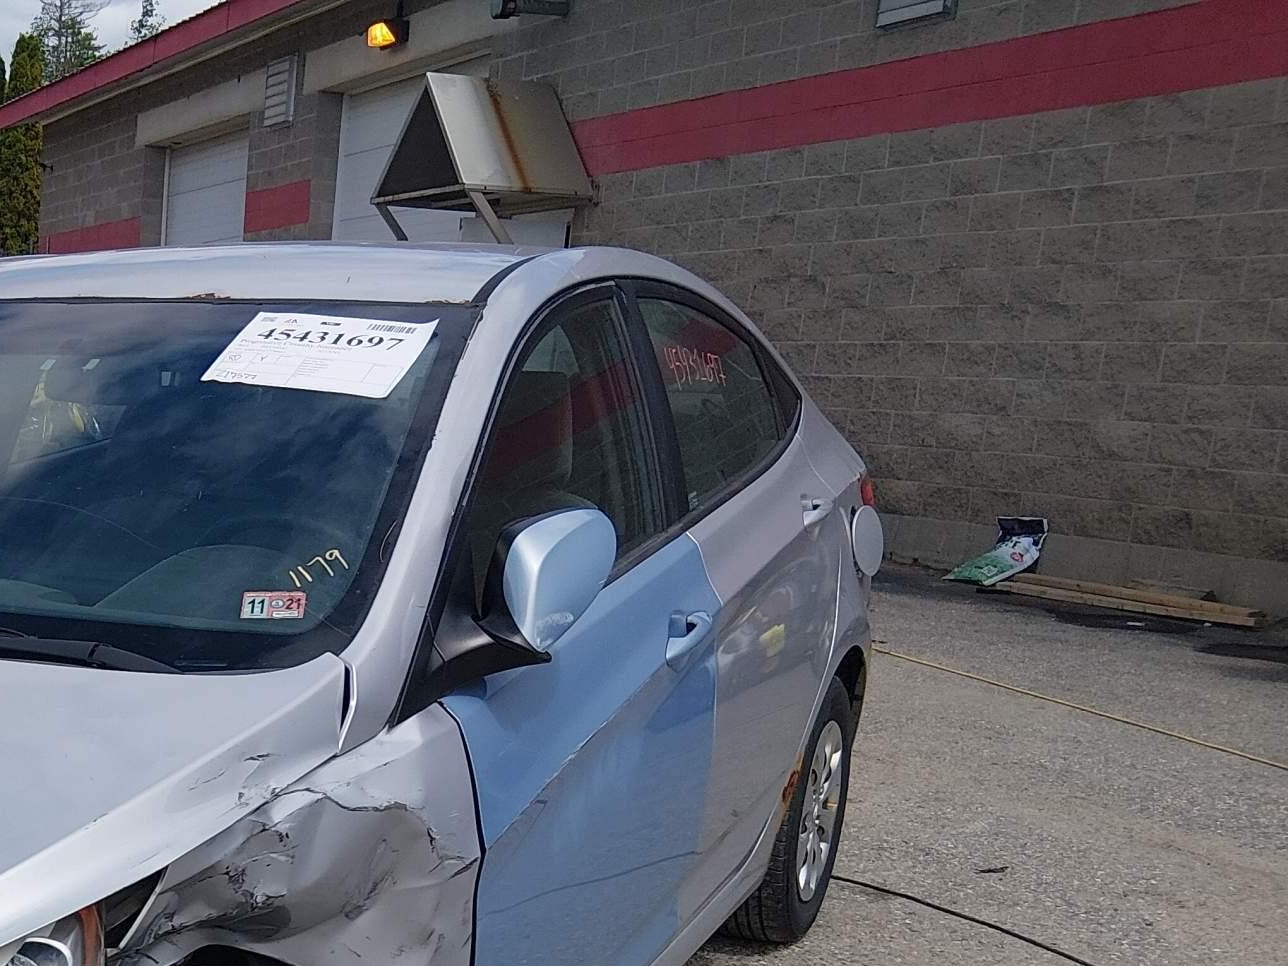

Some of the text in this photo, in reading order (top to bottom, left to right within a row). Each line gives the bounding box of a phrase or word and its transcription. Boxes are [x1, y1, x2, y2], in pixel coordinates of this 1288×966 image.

[257, 327, 407, 351] 45431697
[288, 548, 350, 588] 1179
[247, 598, 266, 615] 11
[285, 598, 302, 610] 21
